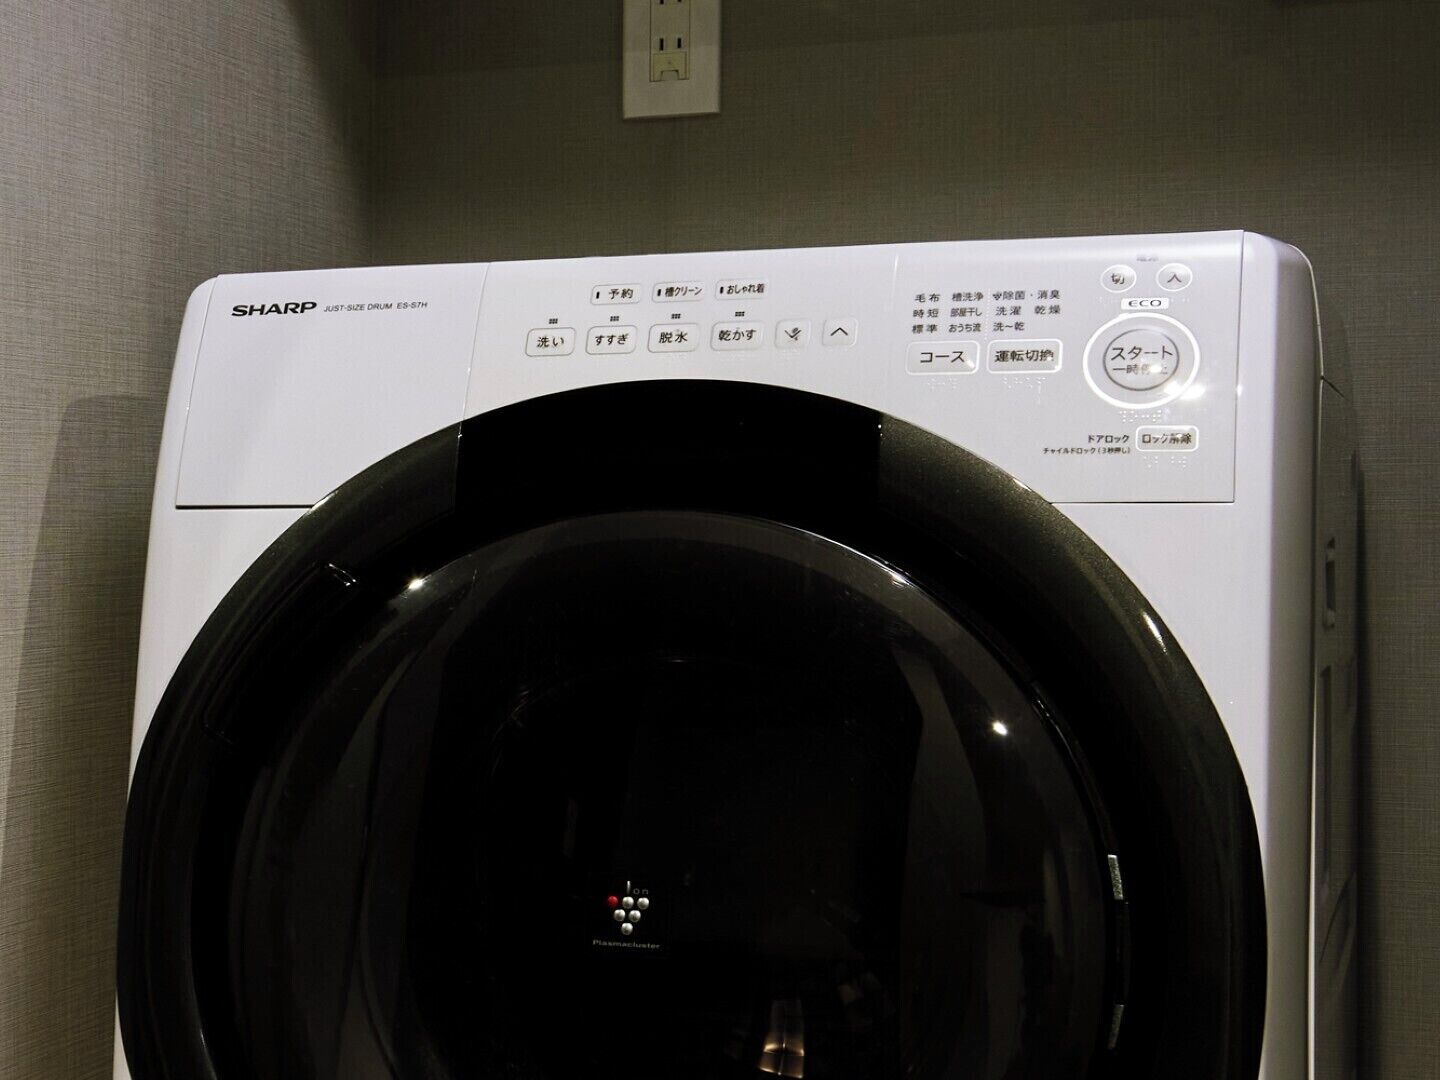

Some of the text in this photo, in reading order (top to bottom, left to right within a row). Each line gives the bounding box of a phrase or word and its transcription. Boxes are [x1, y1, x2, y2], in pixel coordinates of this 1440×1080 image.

[1167, 273, 1182, 284] 入
[608, 283, 765, 300] 予約 槽クリーン おしゃれ着
[915, 292, 940, 303] 毛布
[231, 301, 317, 316] SHARP
[323, 304, 365, 313] JUST-SIZE
[367, 303, 392, 311] DRUM
[1128, 299, 1162, 307] ECO
[995, 306, 1022, 316] 洗濯
[948, 322, 982, 334] おうち流
[536, 328, 757, 349] 洗い すすぎ 脱水 乾かす
[919, 350, 966, 364] コース
[1110, 345, 1173, 361] スタート
[1087, 434, 1129, 444] ドアロック
